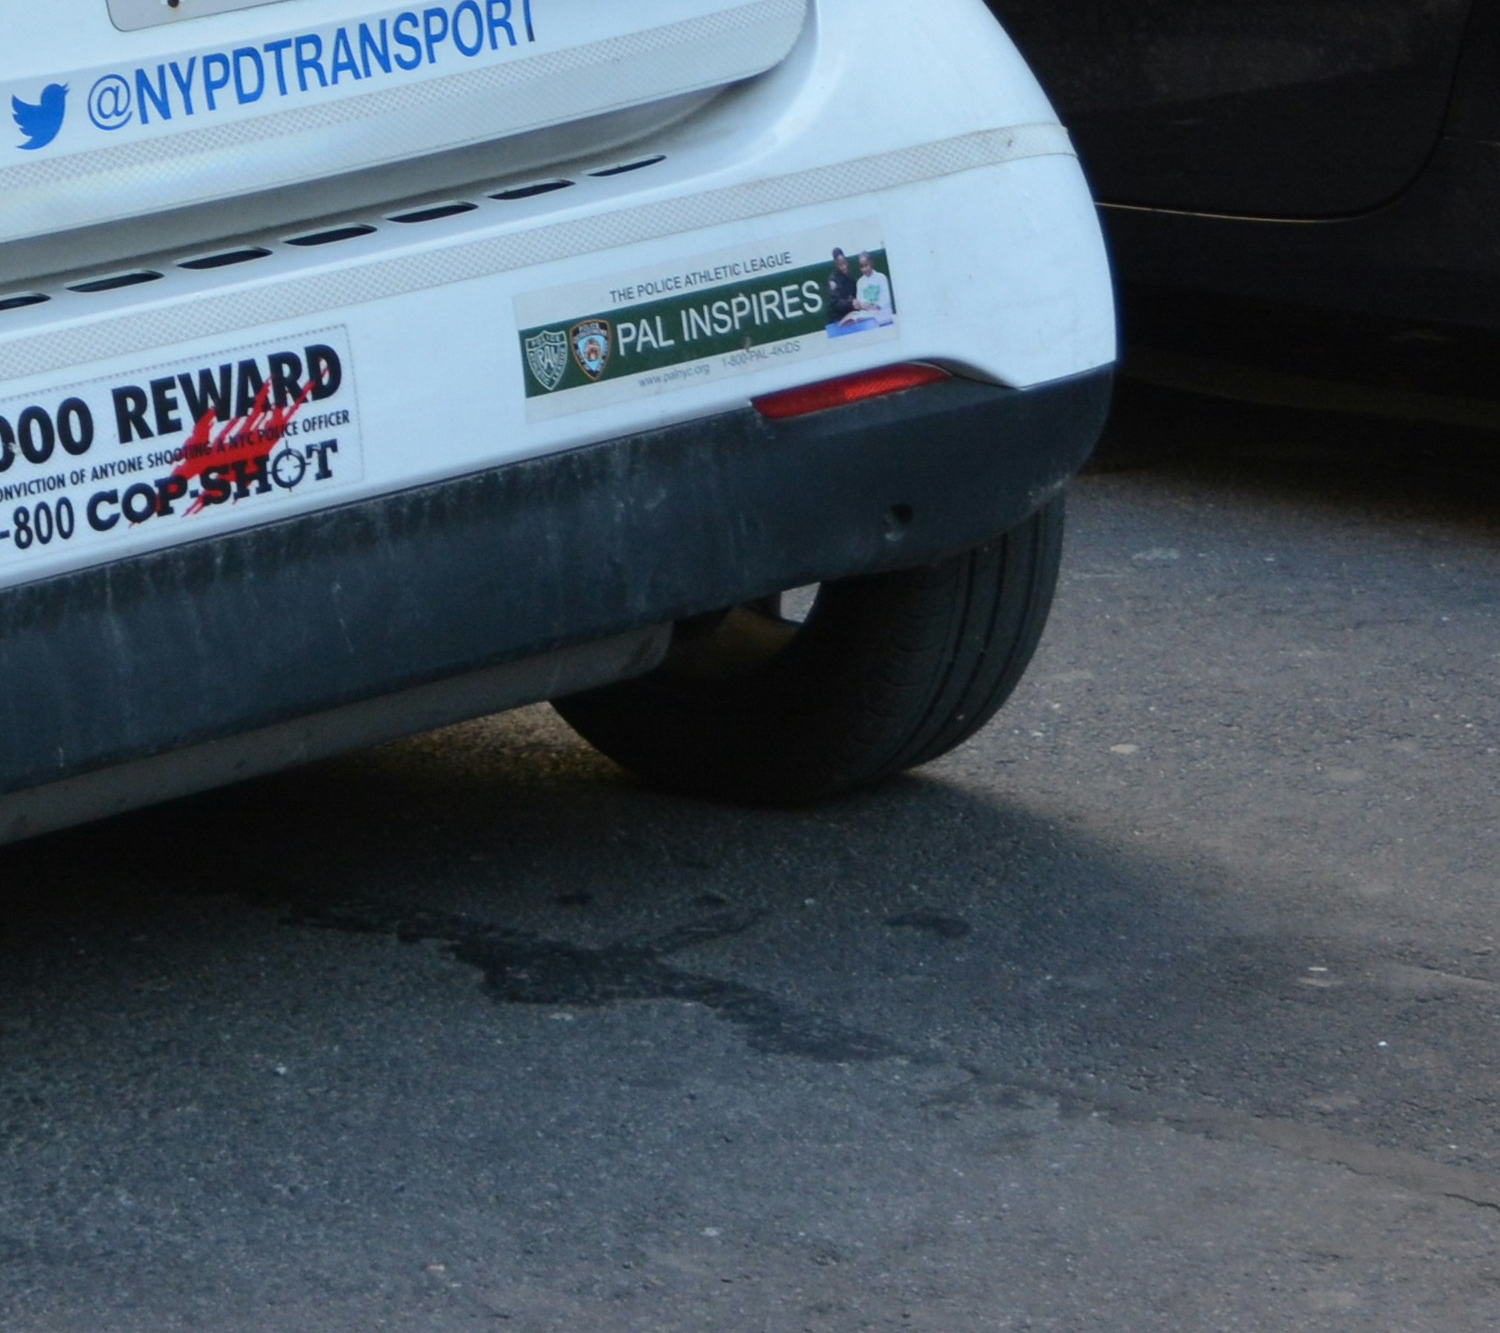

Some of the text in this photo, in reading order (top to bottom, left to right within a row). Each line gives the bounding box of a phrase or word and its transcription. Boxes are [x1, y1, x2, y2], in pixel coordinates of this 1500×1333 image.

[610, 252, 792, 303] THE POLICE ATHLETIC LEAGUE
[617, 280, 823, 356] PAL INSPIRES
[111, 344, 341, 444] REWARD
[70, 469, 85, 485] OF
[91, 456, 144, 482] ANYONE
[146, 441, 212, 468] SHOOTING
[258, 421, 298, 443] POLICE
[302, 410, 350, 433] OFFICER
